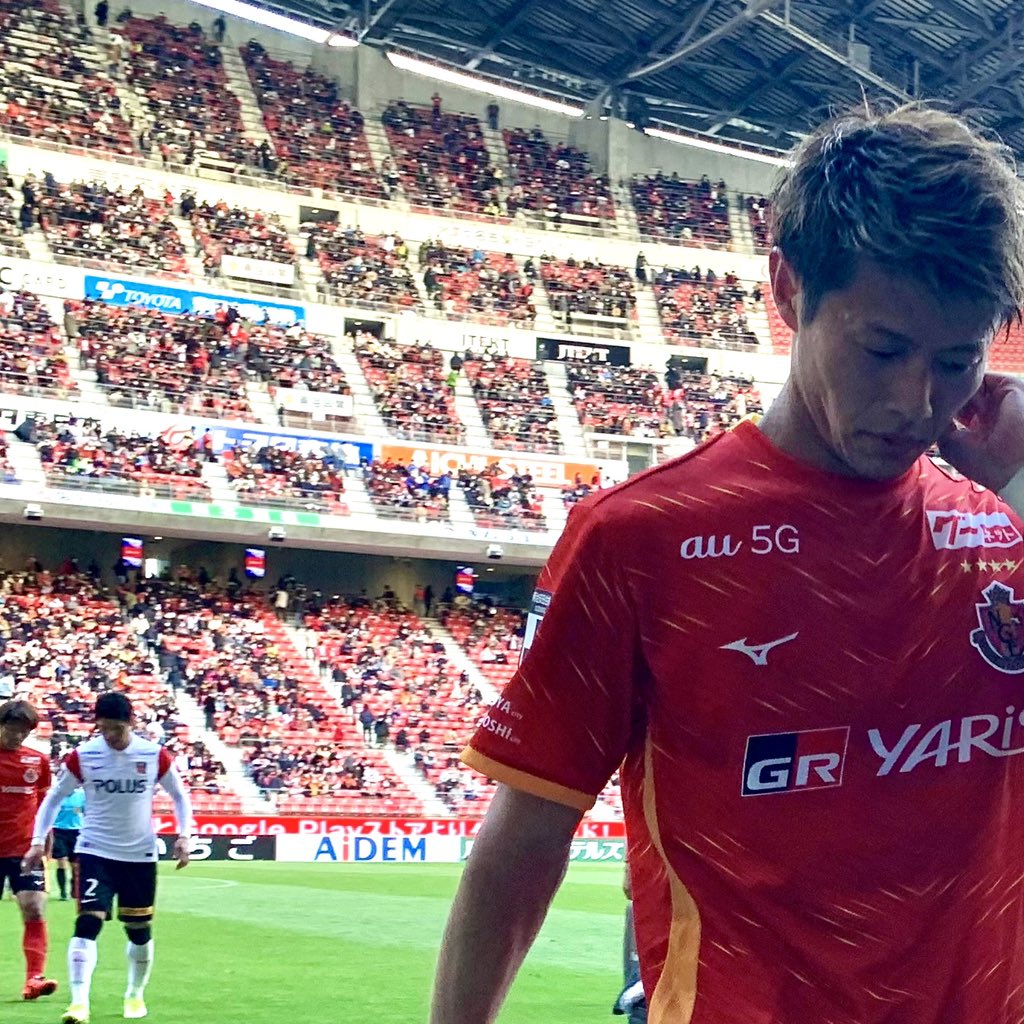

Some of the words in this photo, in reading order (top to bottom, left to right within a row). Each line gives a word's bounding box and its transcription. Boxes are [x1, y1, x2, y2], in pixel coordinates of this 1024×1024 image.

[123, 289, 182, 310] TOYOTA
[680, 531, 740, 560] au
[751, 524, 800, 555] 5G
[746, 752, 840, 790] GR
[93, 779, 148, 793] POLUS
[85, 878, 99, 897] 2
